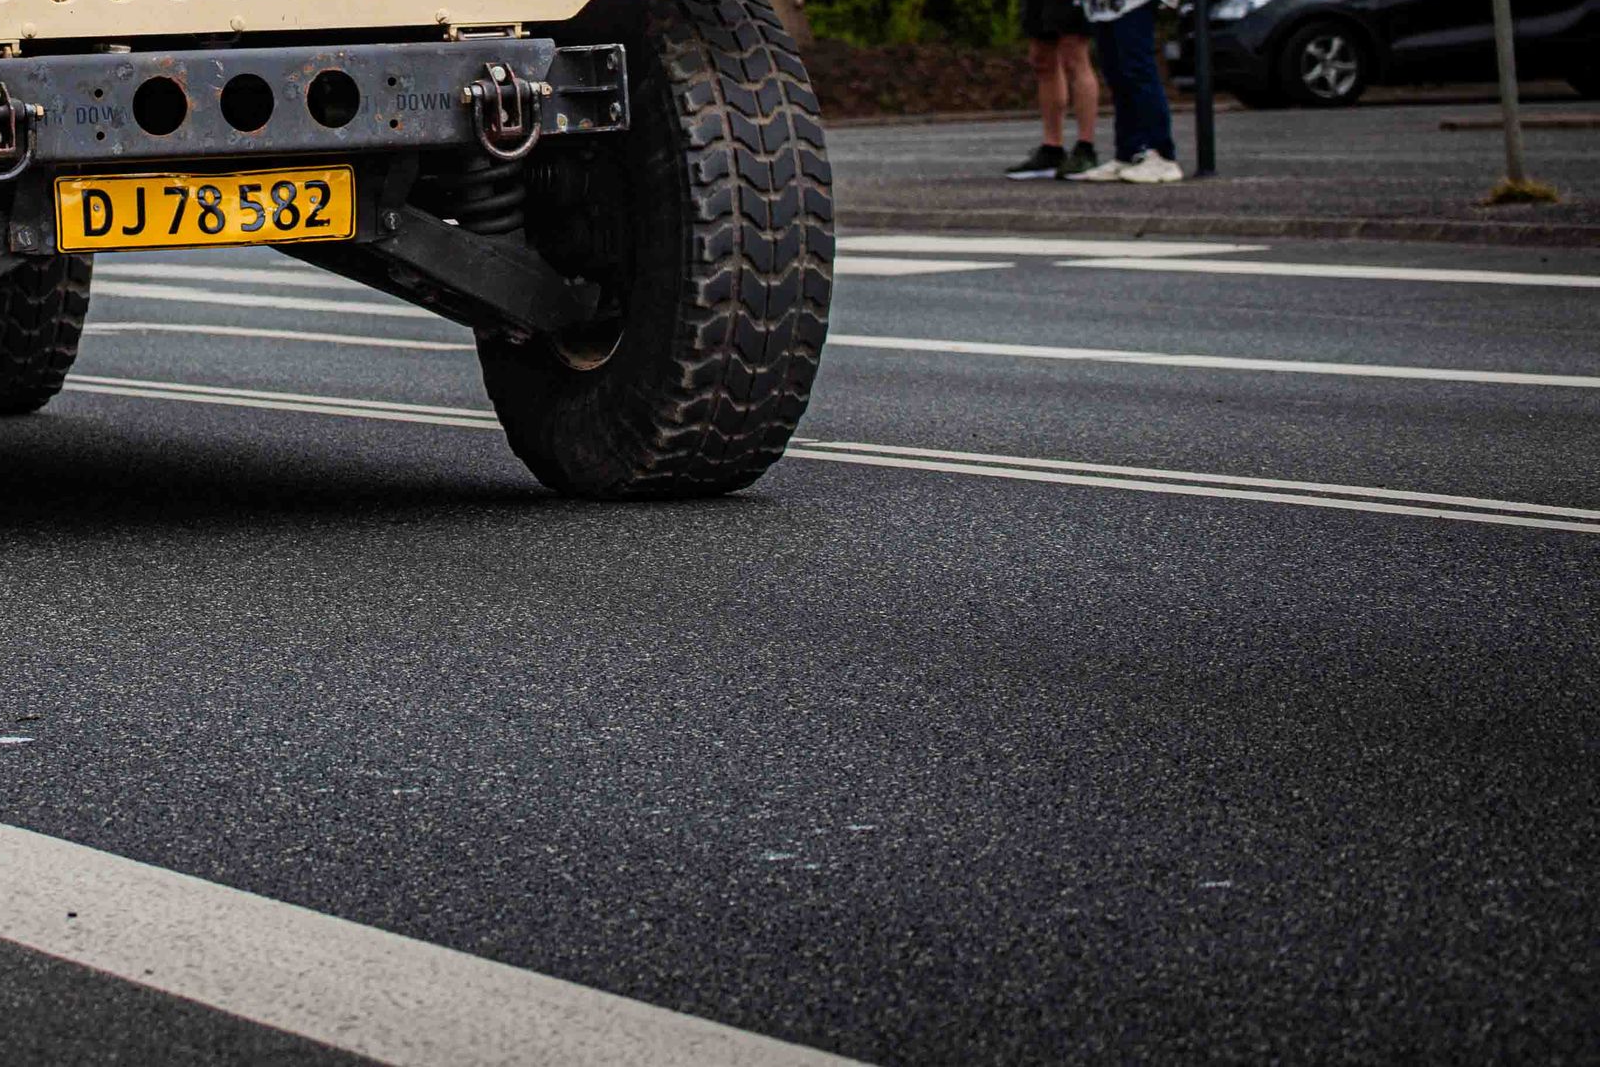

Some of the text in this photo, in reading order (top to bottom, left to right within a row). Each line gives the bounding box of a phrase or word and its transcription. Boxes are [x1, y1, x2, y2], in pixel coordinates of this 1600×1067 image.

[396, 93, 450, 111] DOWN
[82, 179, 332, 237] DJ 78 582
